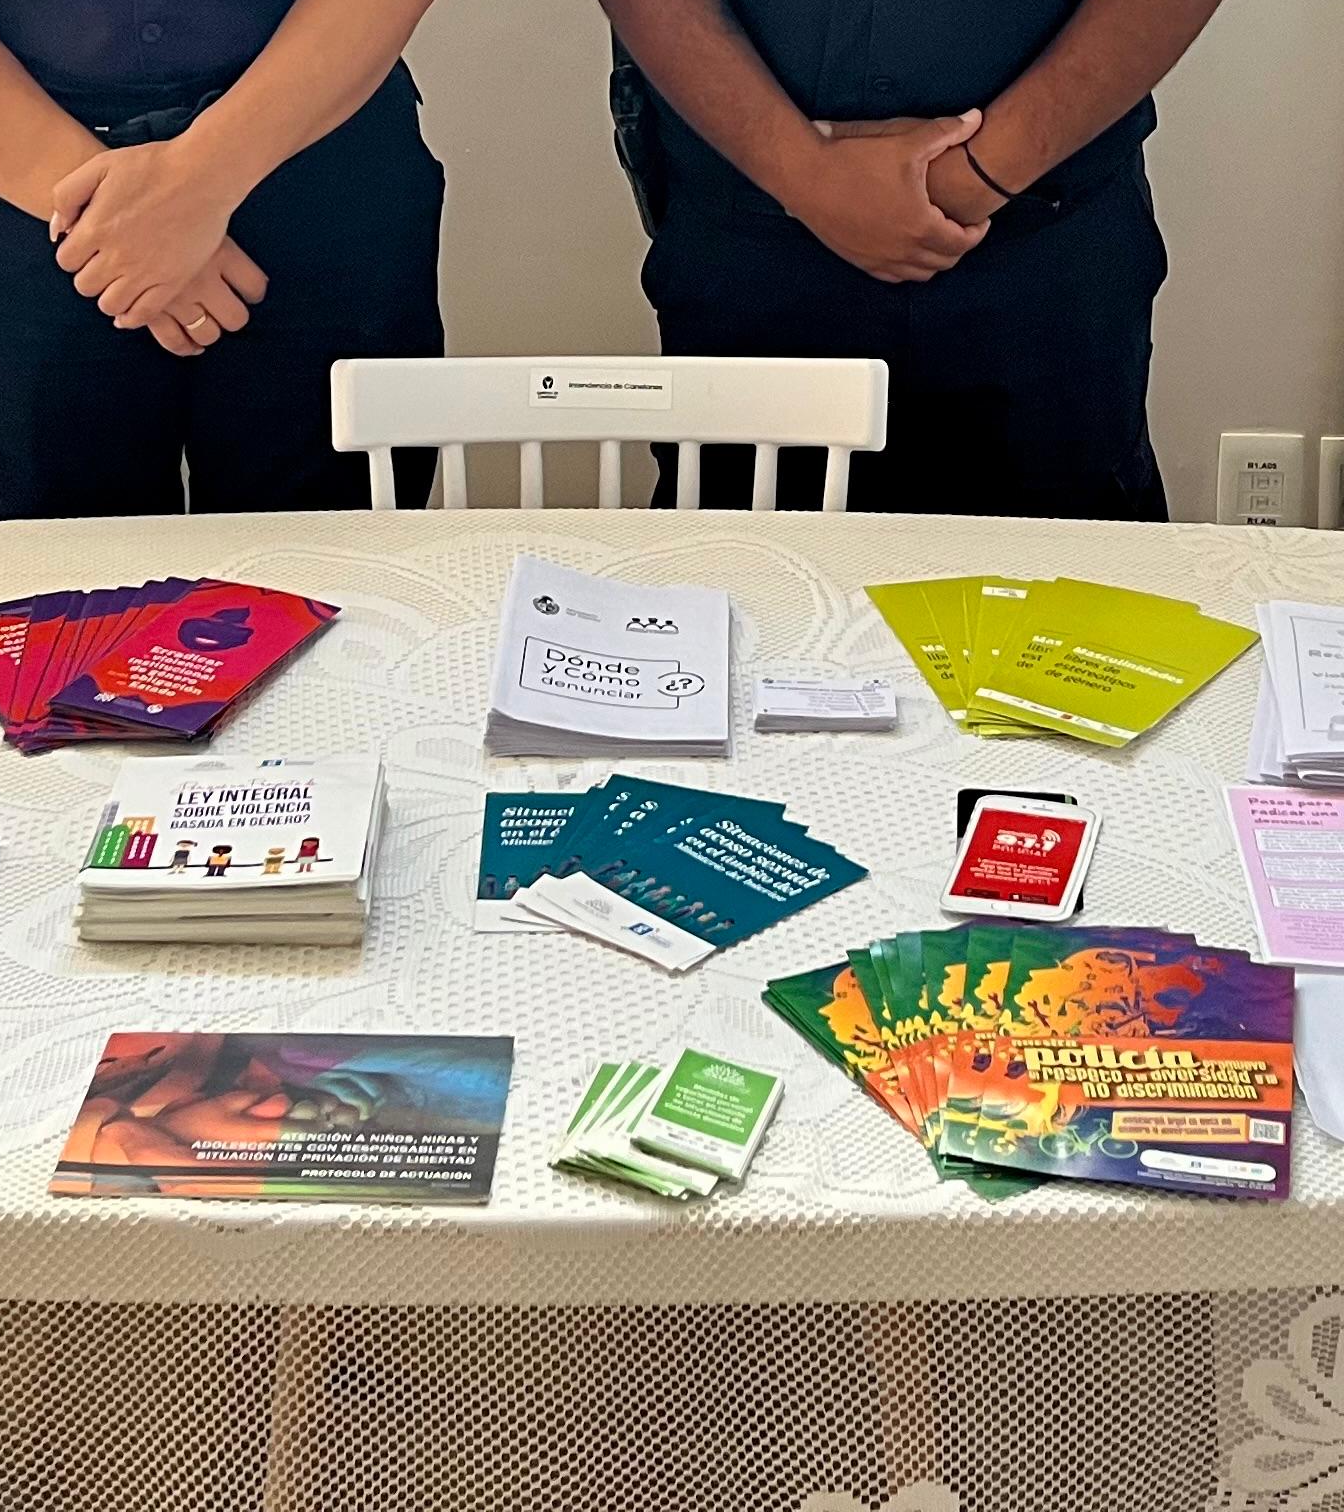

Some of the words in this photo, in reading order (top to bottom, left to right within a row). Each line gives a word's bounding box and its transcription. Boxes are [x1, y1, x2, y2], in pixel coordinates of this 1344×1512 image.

[546, 648, 640, 676] Dónde
[541, 662, 556, 675] y
[564, 666, 640, 687] Cómo
[541, 676, 644, 700] denunciar
[176, 790, 214, 806] LEY
[218, 787, 313, 803] INTEGRAL
[172, 804, 227, 818] SOBRE
[230, 801, 312, 815] VIOLENCIA
[169, 818, 224, 830] BASADA
[227, 816, 247, 828] EN
[1024, 1044, 1203, 1071] policía
[1041, 1066, 1124, 1083] respeto
[1150, 1068, 1252, 1085] diversidad
[1116, 1081, 1258, 1100] discriminación
[280, 1132, 353, 1142] ATENCIÓN
[355, 1133, 366, 1142] A
[470, 1135, 480, 1144] Y
[277, 1153, 297, 1162] DE
[382, 1154, 403, 1164] DE
[406, 1155, 476, 1165] LIBERTAD
[457, 1145, 478, 1155] EN
